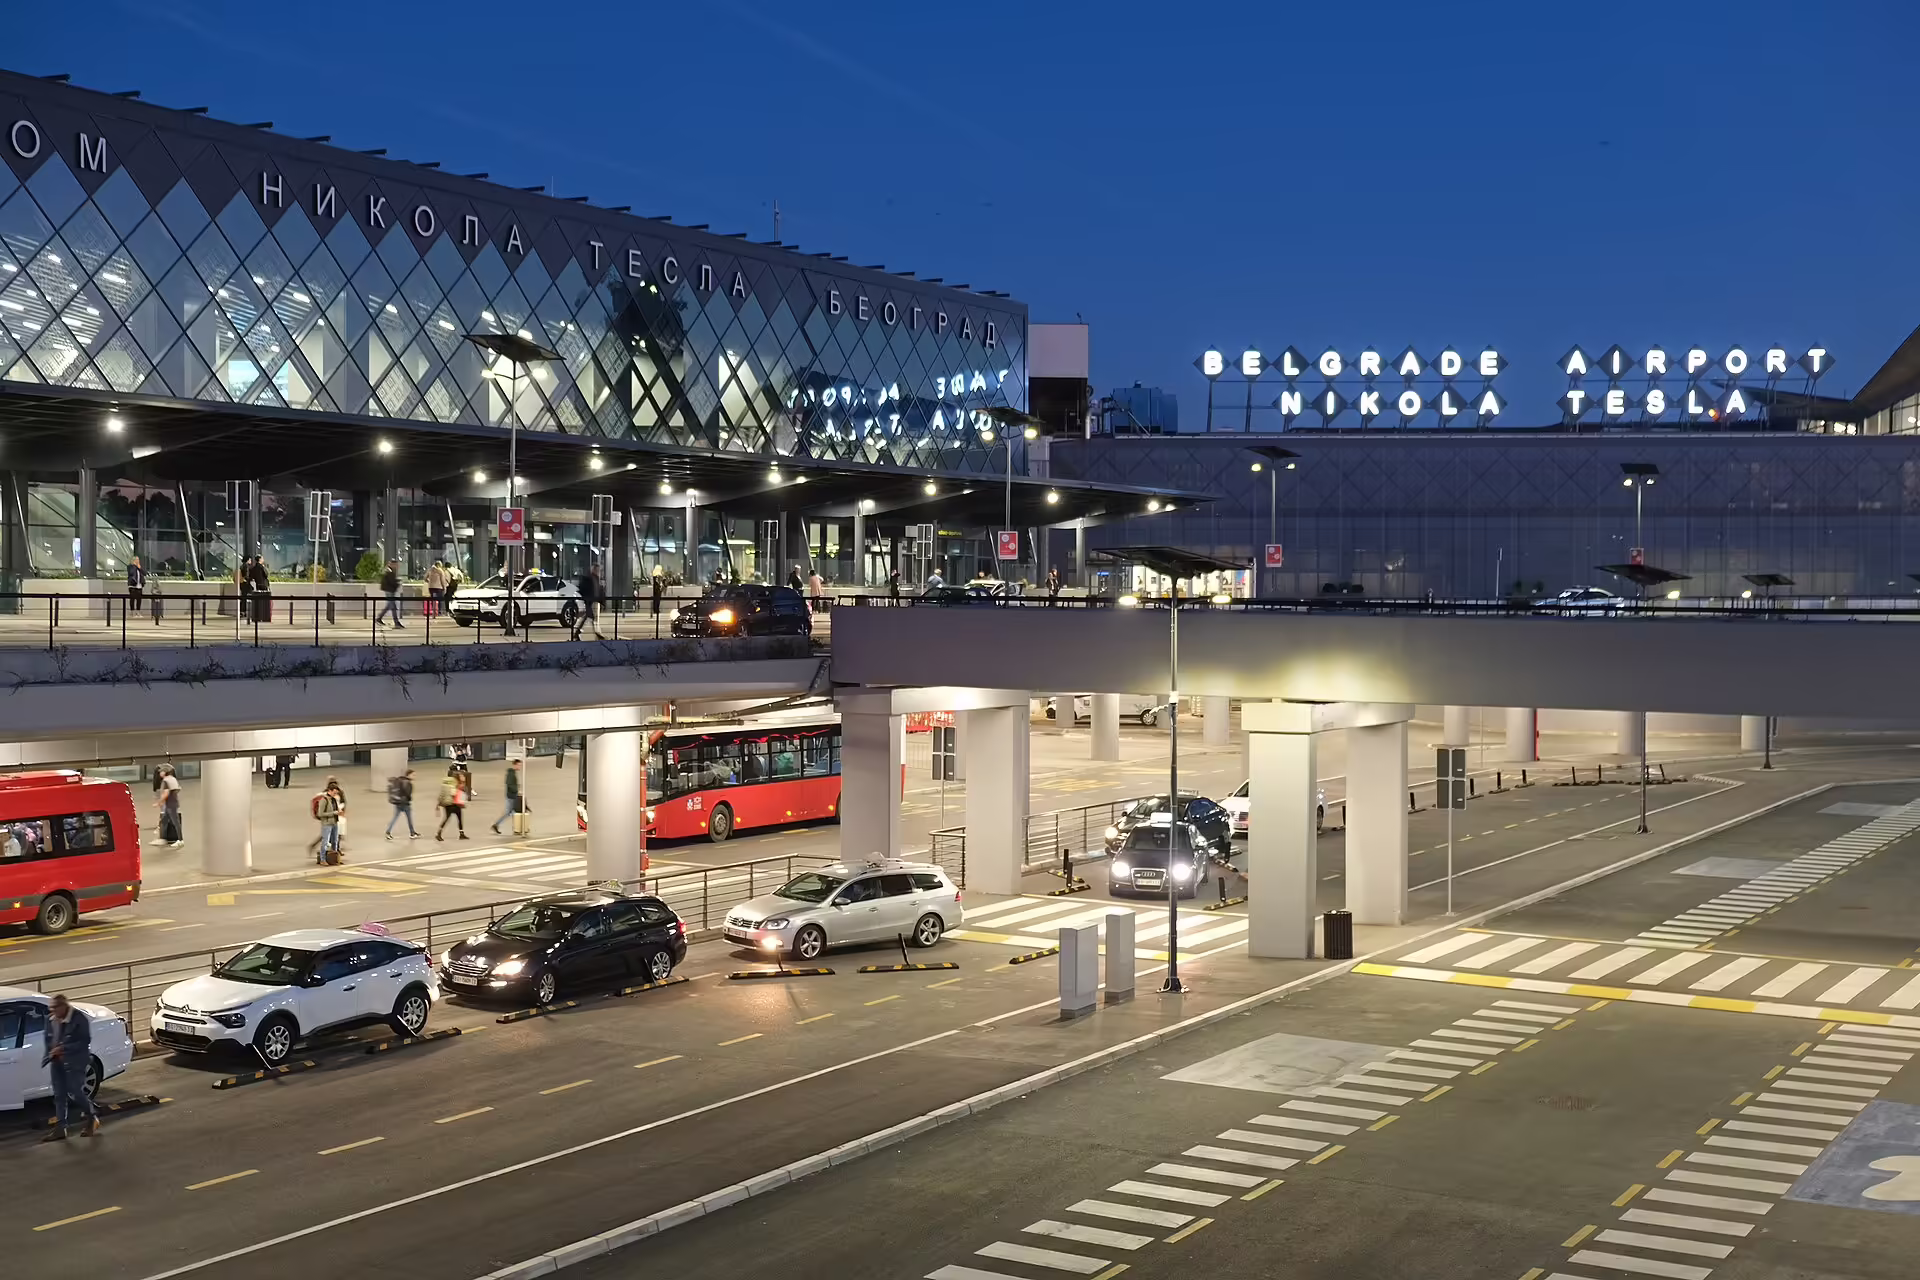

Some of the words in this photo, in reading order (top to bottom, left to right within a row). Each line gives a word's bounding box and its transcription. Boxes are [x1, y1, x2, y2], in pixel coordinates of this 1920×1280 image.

[11, 119, 108, 174] ОМ
[262, 171, 524, 256] НИКОЛА
[589, 240, 746, 299] ТЕСЛА
[829, 289, 997, 349] БЕОГРАД
[1203, 349, 1499, 377] BELGRADE
[1565, 347, 1826, 375] AIRPORT
[1280, 389, 1501, 416] NIKOLA
[1565, 388, 1746, 415] TESLA
